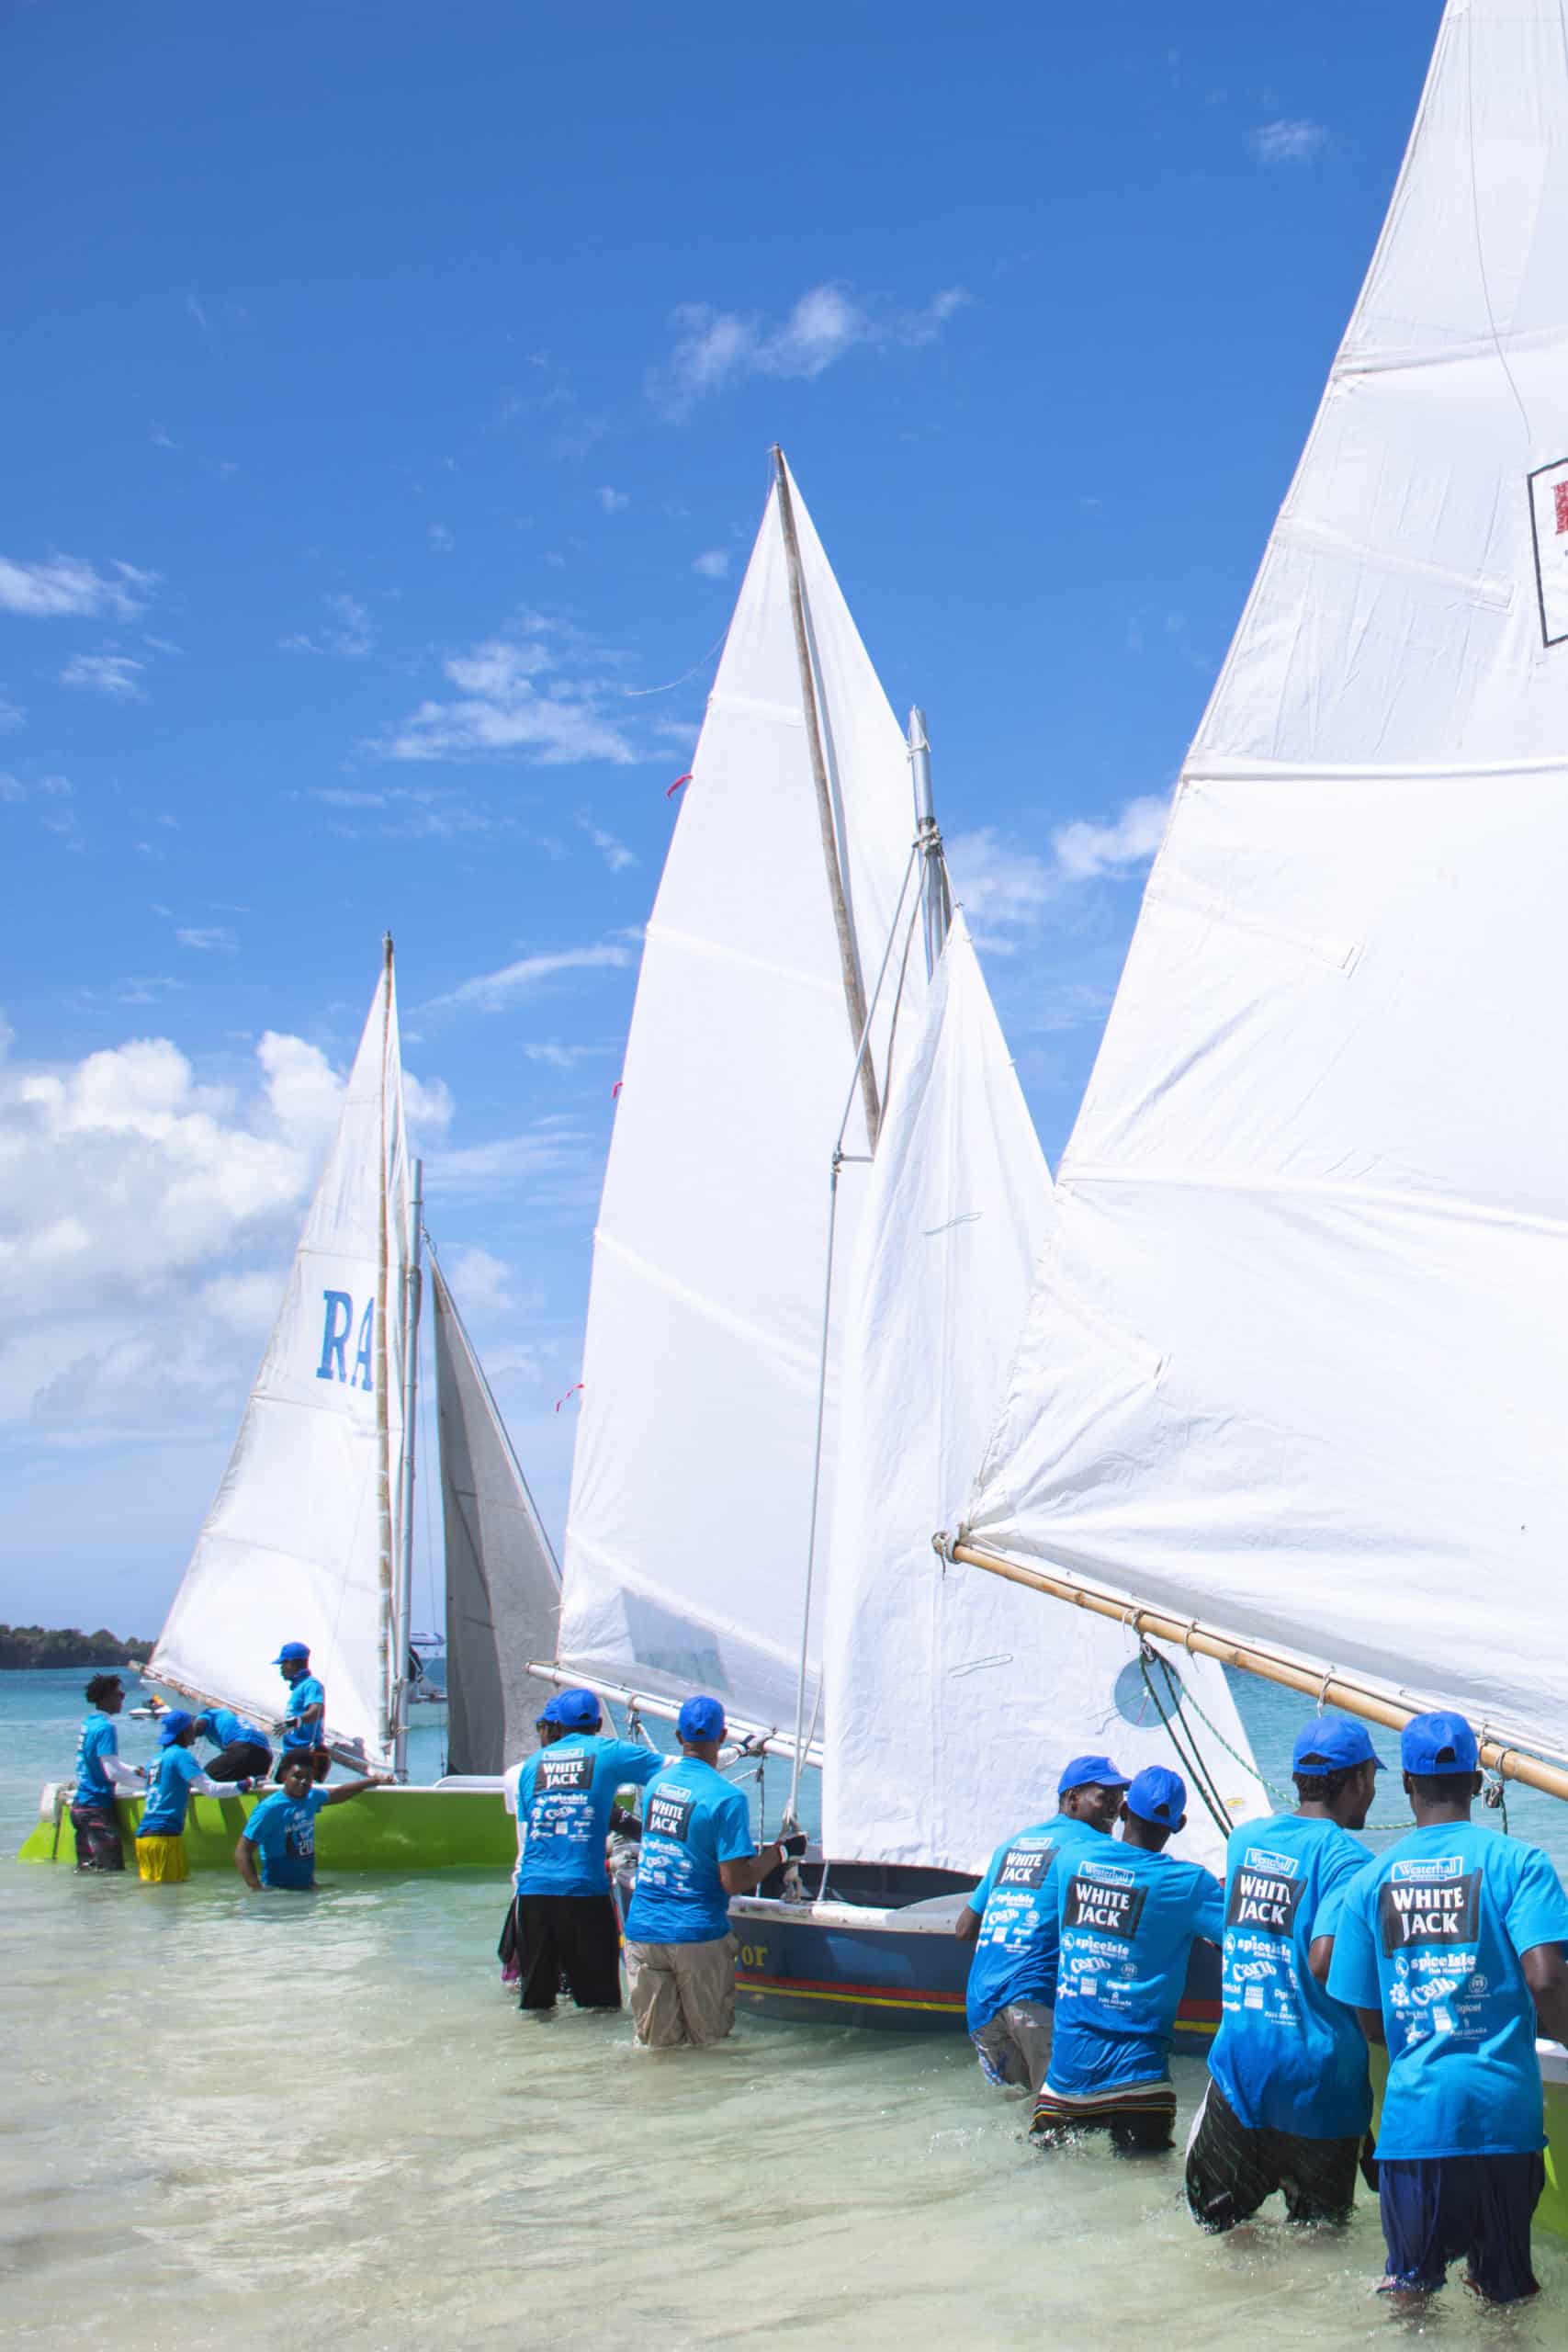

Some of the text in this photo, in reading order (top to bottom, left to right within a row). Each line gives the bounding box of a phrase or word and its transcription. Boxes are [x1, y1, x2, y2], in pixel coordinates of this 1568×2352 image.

[543, 1760, 585, 1774] WHITE
[546, 1772, 580, 1790] JACK
[651, 1799, 684, 1820] WHITE
[649, 1814, 678, 1834] JACK
[1006, 1851, 1043, 1867] WHITE
[999, 1866, 1034, 1884] JACK
[1076, 1883, 1131, 1910] WHITE
[1391, 1886, 1464, 1911] WHITE
[1076, 1903, 1122, 1928] JACK
[1237, 1897, 1287, 1926] JACK
[1401, 1912, 1459, 1942] JACK
